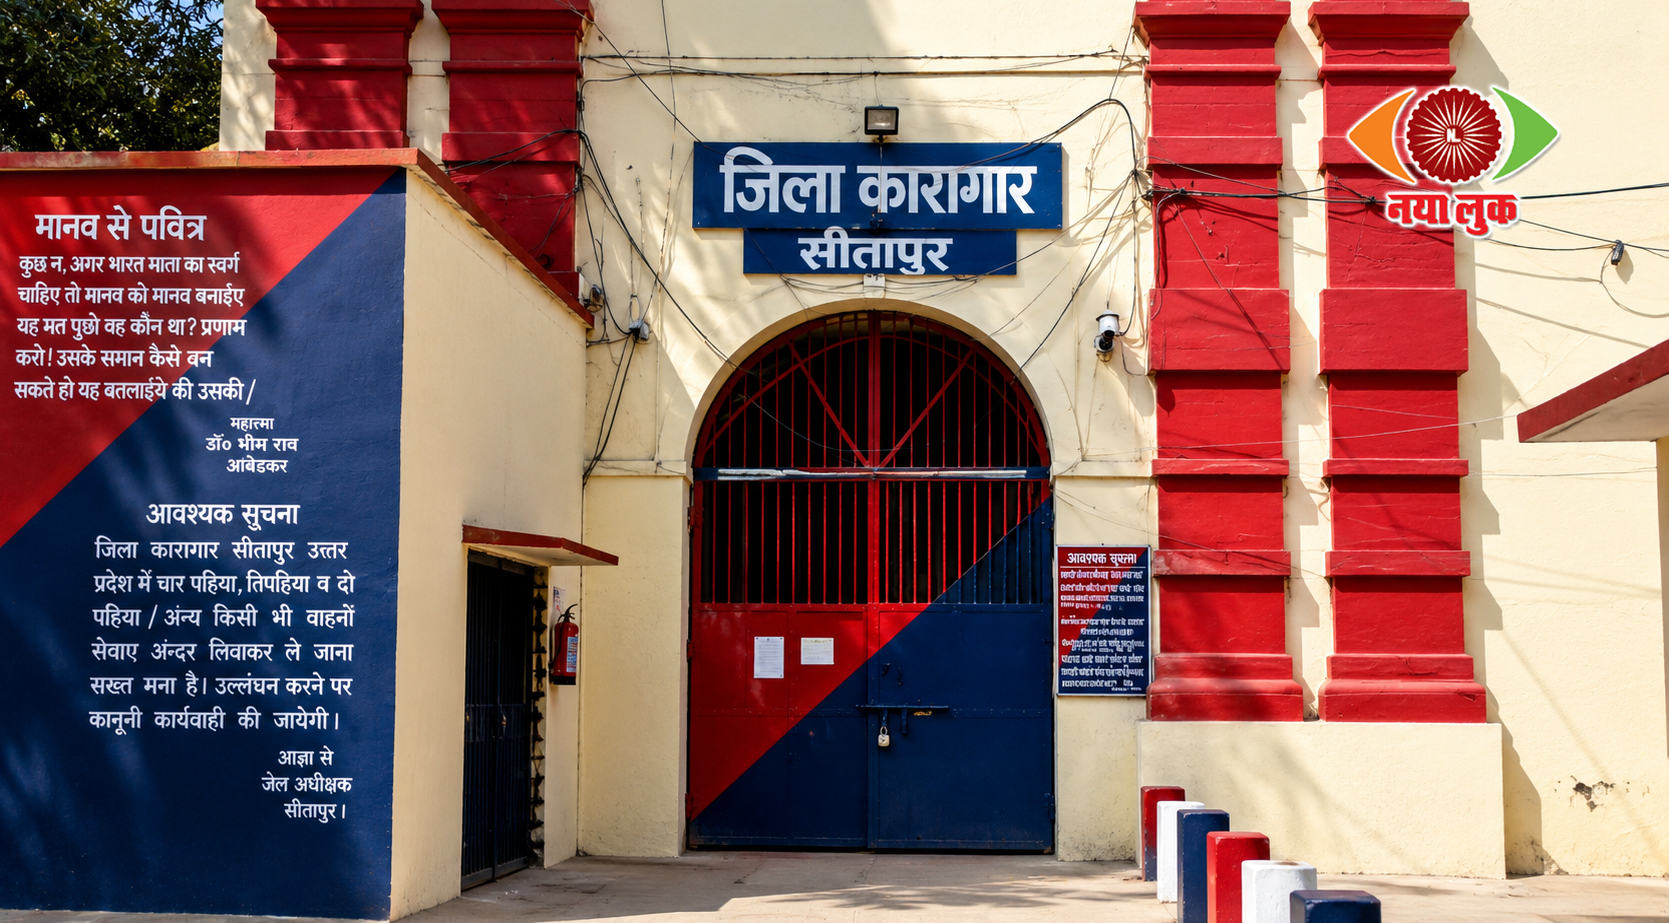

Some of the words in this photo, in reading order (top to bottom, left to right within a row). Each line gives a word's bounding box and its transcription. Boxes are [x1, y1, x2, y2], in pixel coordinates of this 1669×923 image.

[719, 146, 845, 213] जिला
[857, 166, 1037, 214] कारागार
[35, 215, 100, 240] मानव
[106, 205, 132, 240] से
[140, 205, 207, 240] पवित्र
[797, 226, 953, 275] सीतापुर
[19, 256, 47, 278] कुछ
[70, 256, 105, 272] अगर
[109, 257, 145, 272] भारत
[148, 257, 182, 272] माता
[184, 257, 205, 273] का
[207, 252, 240, 273] स्वर्ग
[18, 281, 61, 305] चाहिए
[64, 281, 81, 303] तो
[84, 288, 124, 303] मानव
[128, 282, 149, 303] को
[152, 288, 192, 304] मानव
[195, 283, 245, 307] बनाईए
[17, 318, 40, 336] यह
[43, 319, 67, 334] मत
[104, 319, 126, 337] वह
[201, 320, 247, 336] प्रणाम
[57, 344, 96, 366] उसके
[100, 350, 145, 367] समान
[149, 343, 182, 367] कैसे
[14, 376, 55, 398] सकते
[58, 376, 75, 400] हो
[78, 382, 101, 400] यह
[104, 377, 168, 401] बतलाईये
[172, 377, 194, 399] की
[230, 418, 274, 432] महात्मा
[238, 434, 268, 451] भीम
[272, 438, 299, 451] राव
[146, 504, 235, 524] आवश्यक
[94, 535, 139, 558] जिला
[150, 542, 220, 559] कारागार
[232, 536, 295, 565] सीतापुर
[307, 542, 348, 559] उत्तर
[94, 569, 133, 593] प्रदेश
[138, 569, 152, 592] में
[156, 576, 185, 592] चार
[246, 570, 310, 594] तिपहिया
[317, 576, 330, 592] व
[337, 569, 356, 594] दो
[92, 603, 141, 628] पहिया
[213, 603, 258, 626] किसी
[272, 604, 293, 626] भी
[306, 604, 355, 628] वाहनों
[91, 637, 139, 662] सेवाए
[209, 637, 273, 661] लिवाकर
[285, 637, 302, 661] ले
[314, 644, 354, 661] जाना
[90, 678, 134, 694] सख्त
[143, 678, 177, 694] मना
[215, 672, 280, 695] उल्लंघन
[285, 672, 325, 695] करने
[330, 679, 353, 695] पर
[89, 706, 143, 735] कानूनी
[154, 706, 226, 731] कार्यवाही
[237, 706, 261, 729] की
[278, 751, 314, 767] आज्ञा
[319, 745, 334, 765] से
[262, 771, 289, 791] जेल
[295, 772, 353, 794] अधीक्षक
